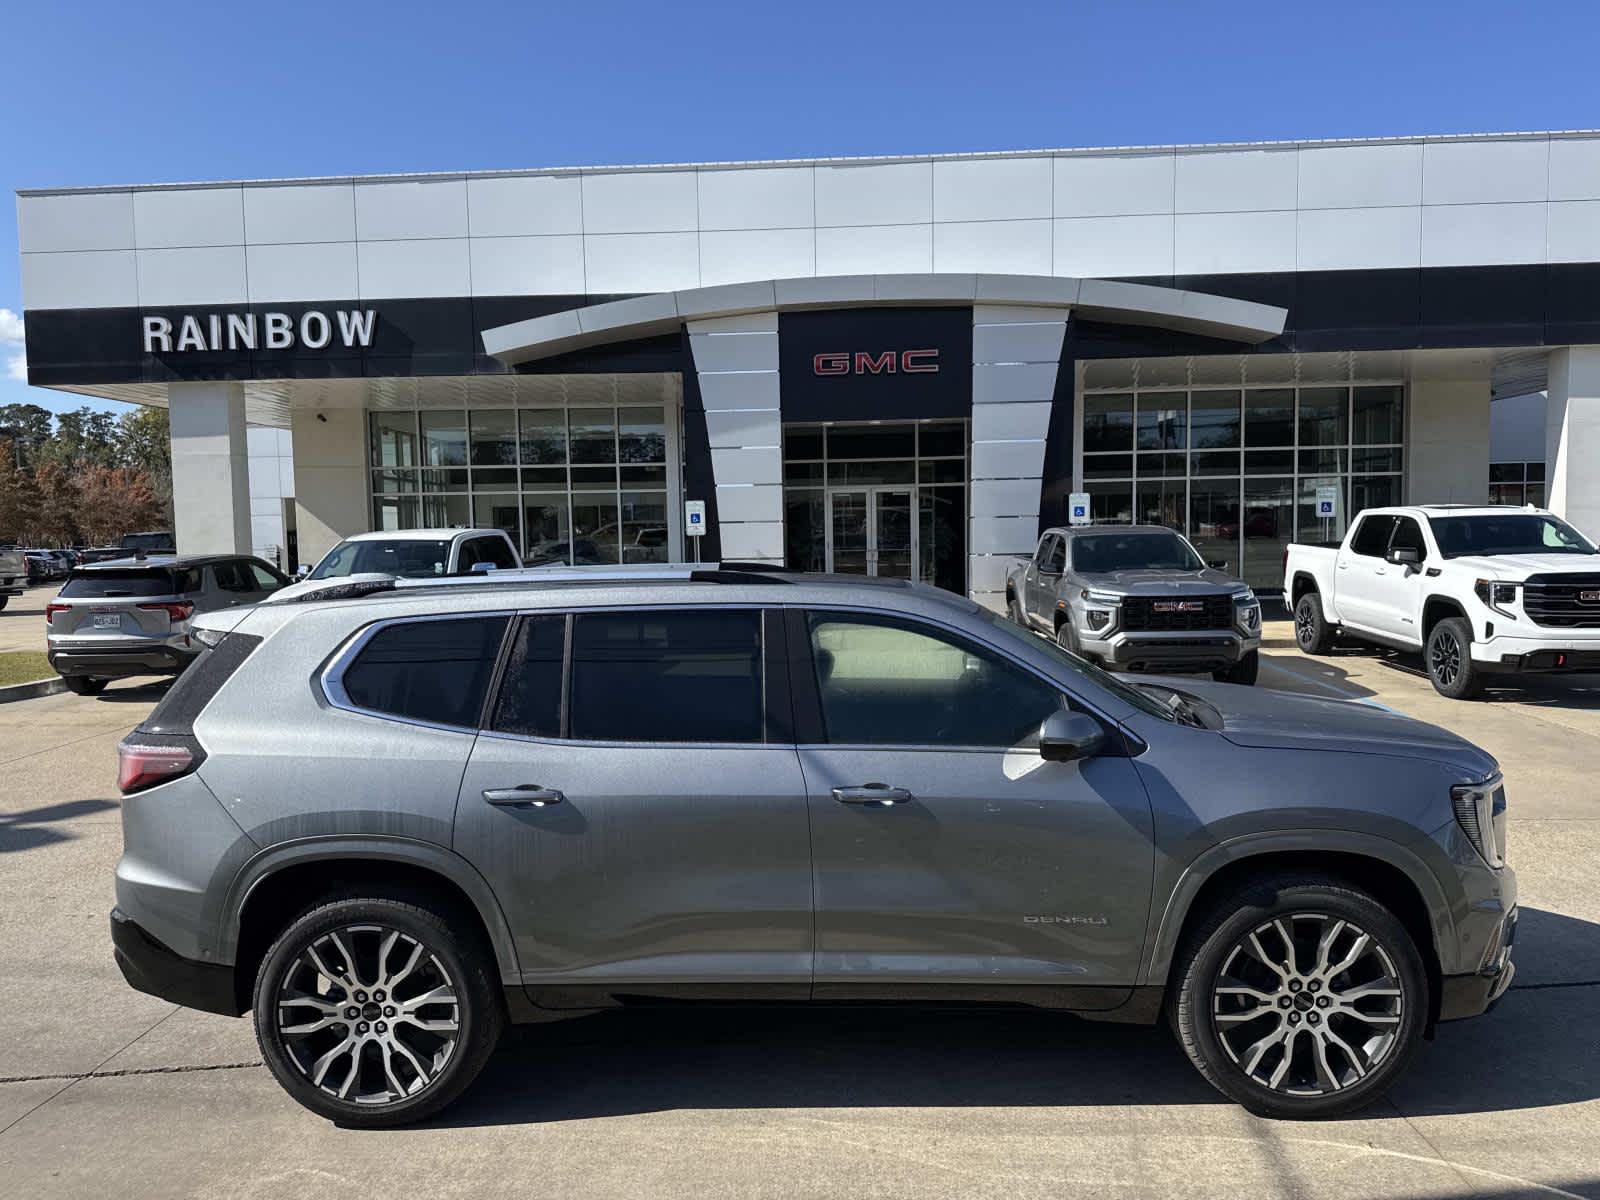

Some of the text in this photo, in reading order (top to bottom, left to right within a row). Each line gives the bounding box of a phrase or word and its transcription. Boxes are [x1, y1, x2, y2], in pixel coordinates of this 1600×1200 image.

[142, 310, 376, 352] RAINBOW
[813, 348, 939, 375] GMC
[1023, 915, 1108, 925] DENALI
